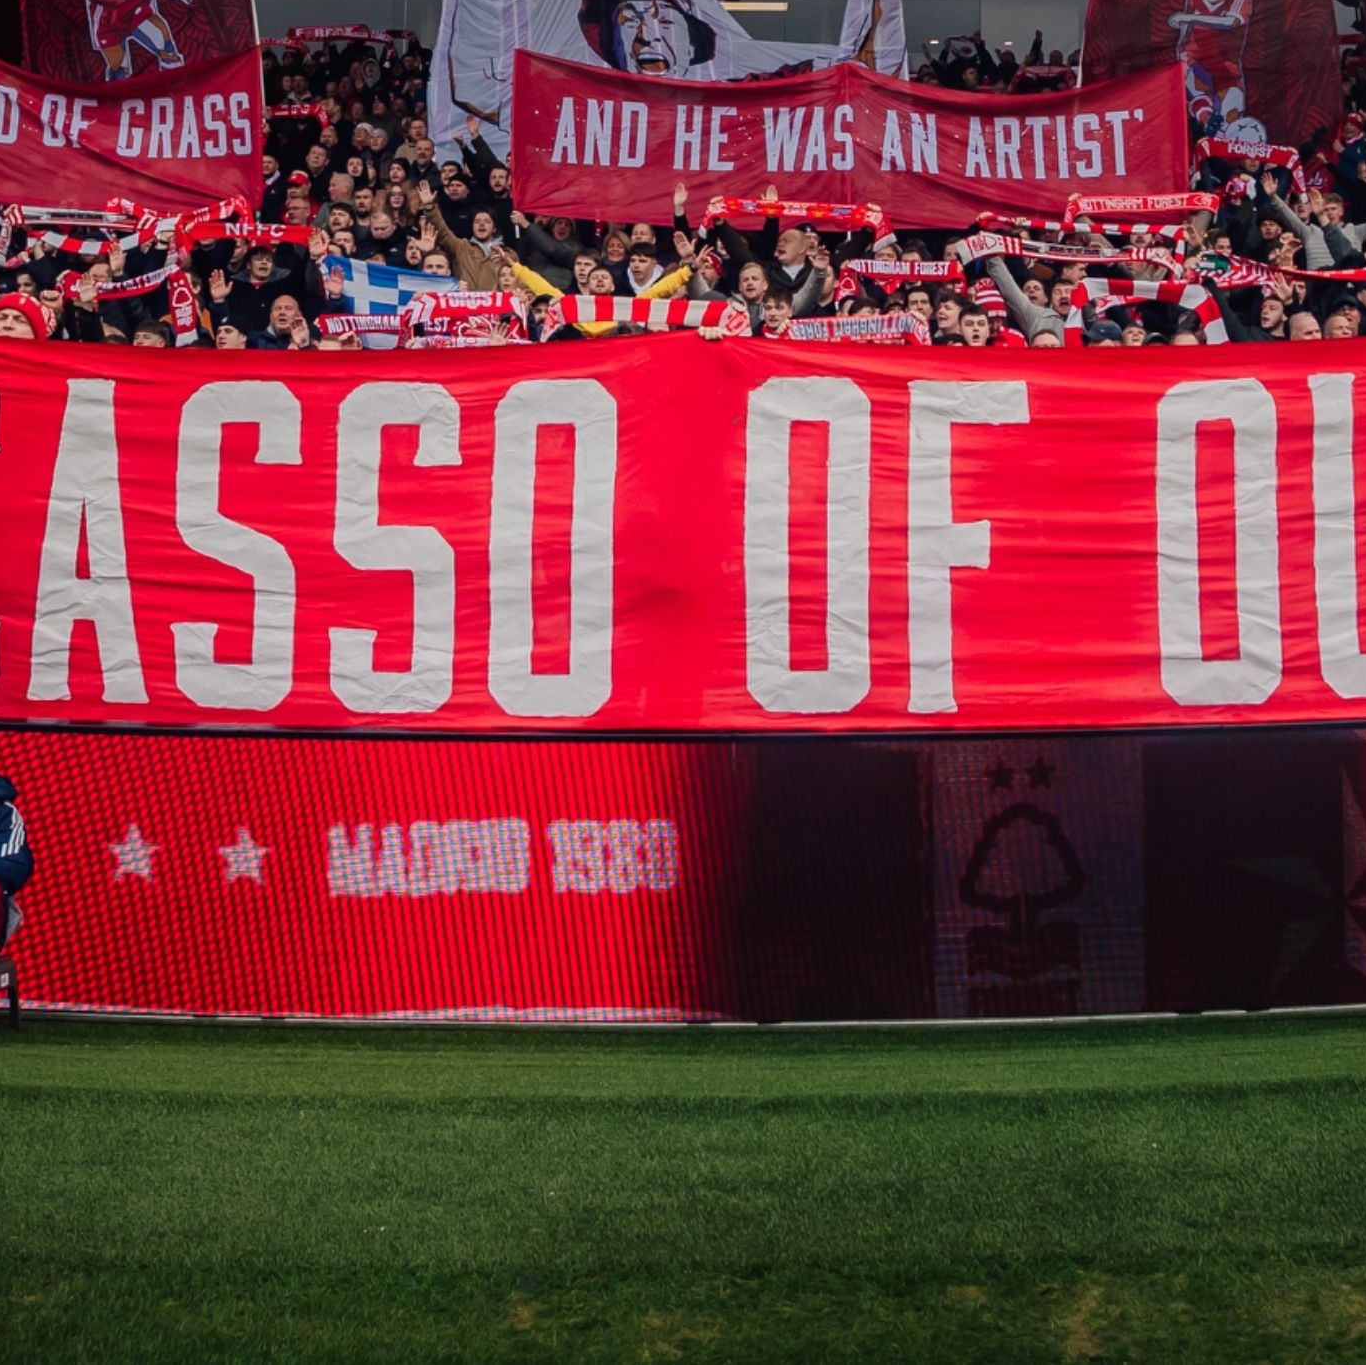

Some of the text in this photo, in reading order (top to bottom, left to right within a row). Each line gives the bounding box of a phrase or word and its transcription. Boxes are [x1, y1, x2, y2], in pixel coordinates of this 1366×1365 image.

[41, 94, 97, 148] OF
[118, 91, 252, 159] GRASS
[551, 96, 1144, 179] AND HE WAS AN ARTIST'
[225, 223, 286, 237] NFFC
[1077, 194, 1186, 212] NOTTINGHAM FOREST
[325, 315, 401, 333] NOTTINGHAM
[743, 373, 1032, 715] OF
[327, 816, 529, 897] MADRID
